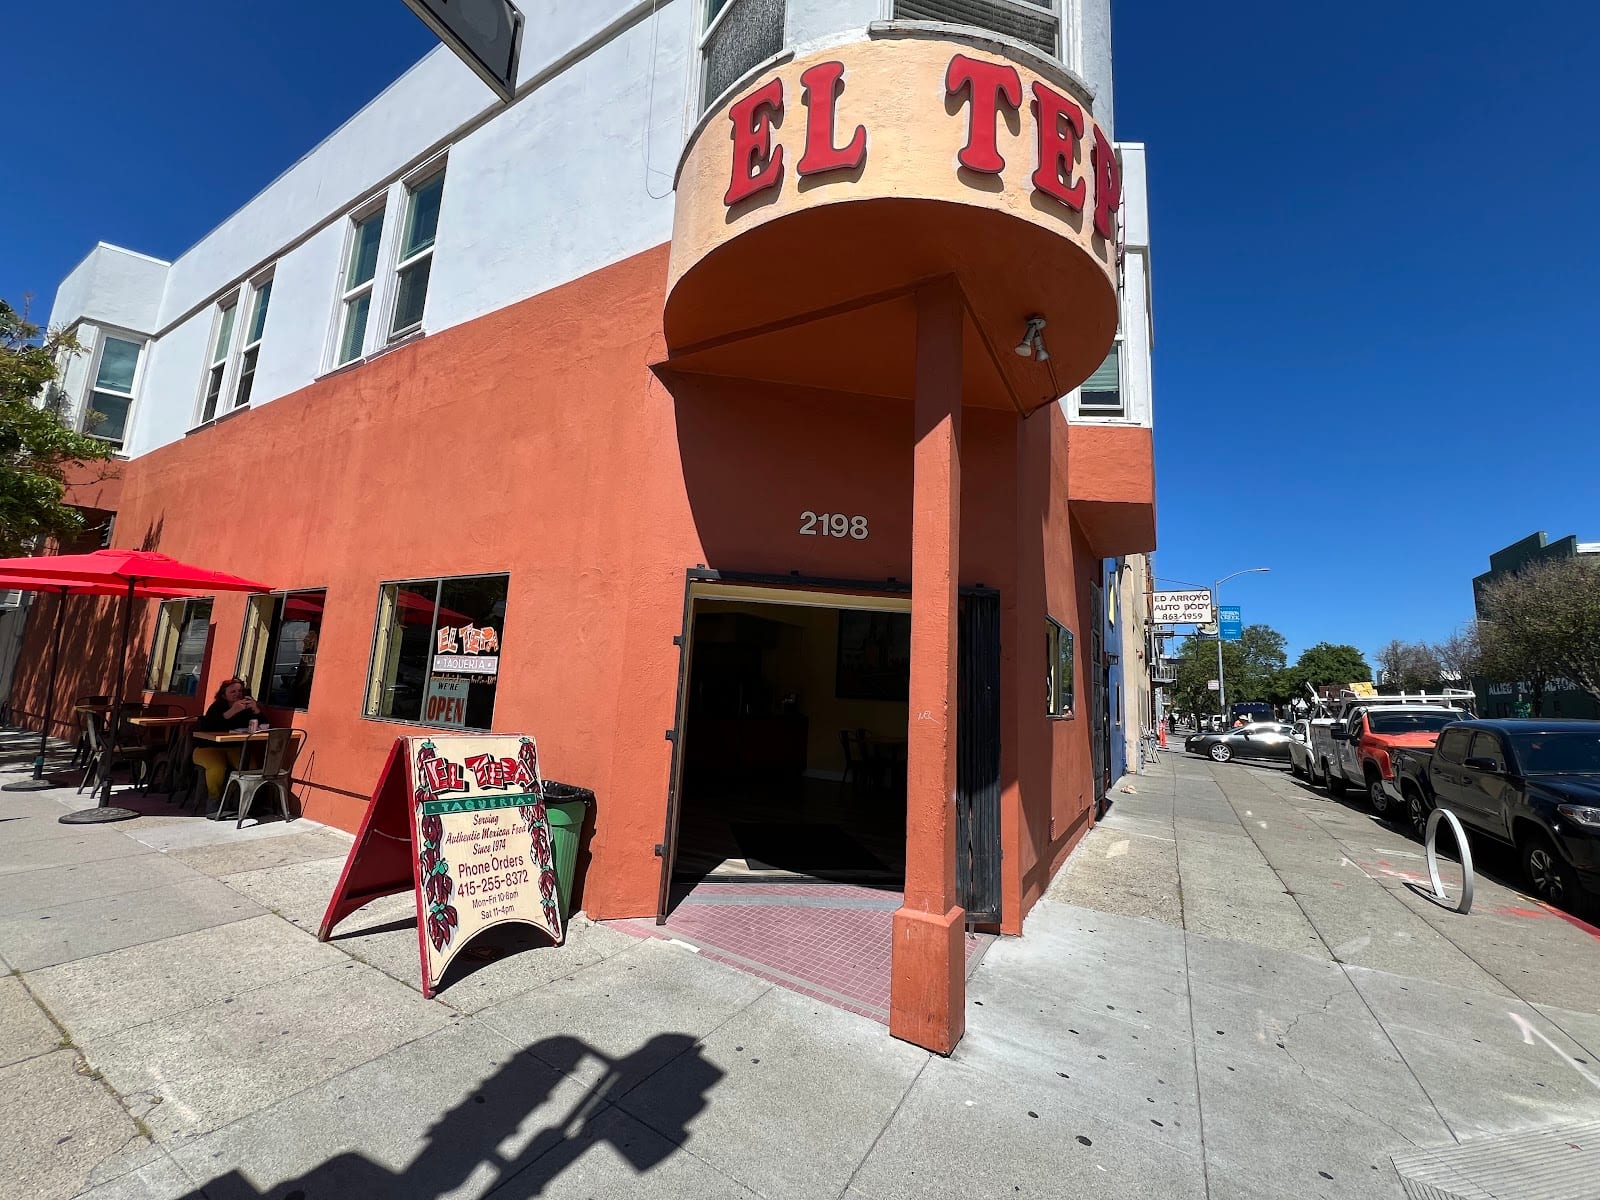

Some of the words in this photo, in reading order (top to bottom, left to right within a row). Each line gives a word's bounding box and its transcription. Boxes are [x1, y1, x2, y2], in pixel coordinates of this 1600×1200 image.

[724, 60, 867, 207] EL
[945, 53, 1122, 239] TEP
[799, 510, 869, 540] 2198
[1154, 595, 1167, 603] ED
[1169, 594, 1210, 602] ARROYO
[1154, 603, 1180, 611] AUTO
[1183, 603, 1210, 611] BODY
[437, 625, 459, 655] EL
[458, 622, 500, 655] TEPA
[443, 657, 486, 669] TAQUERIA
[437, 682, 460, 691] WE'RE
[427, 694, 466, 723] OPEN
[423, 757, 466, 792] EL
[464, 753, 535, 788] TEPA
[441, 797, 526, 812] TAQUERIA
[472, 813, 499, 826] Serving
[445, 830, 481, 845] Authentic
[481, 827, 510, 840] Mexican
[511, 822, 527, 835] Food
[472, 842, 491, 855] Since
[492, 839, 506, 853] 1974
[458, 862, 491, 879] Phone
[491, 855, 524, 871] Orders
[457, 869, 529, 898] 415-255-8372
[472, 894, 497, 909] Mon-Fri
[481, 910, 493, 919] Sat
[493, 905, 515, 916] 11-4pm
